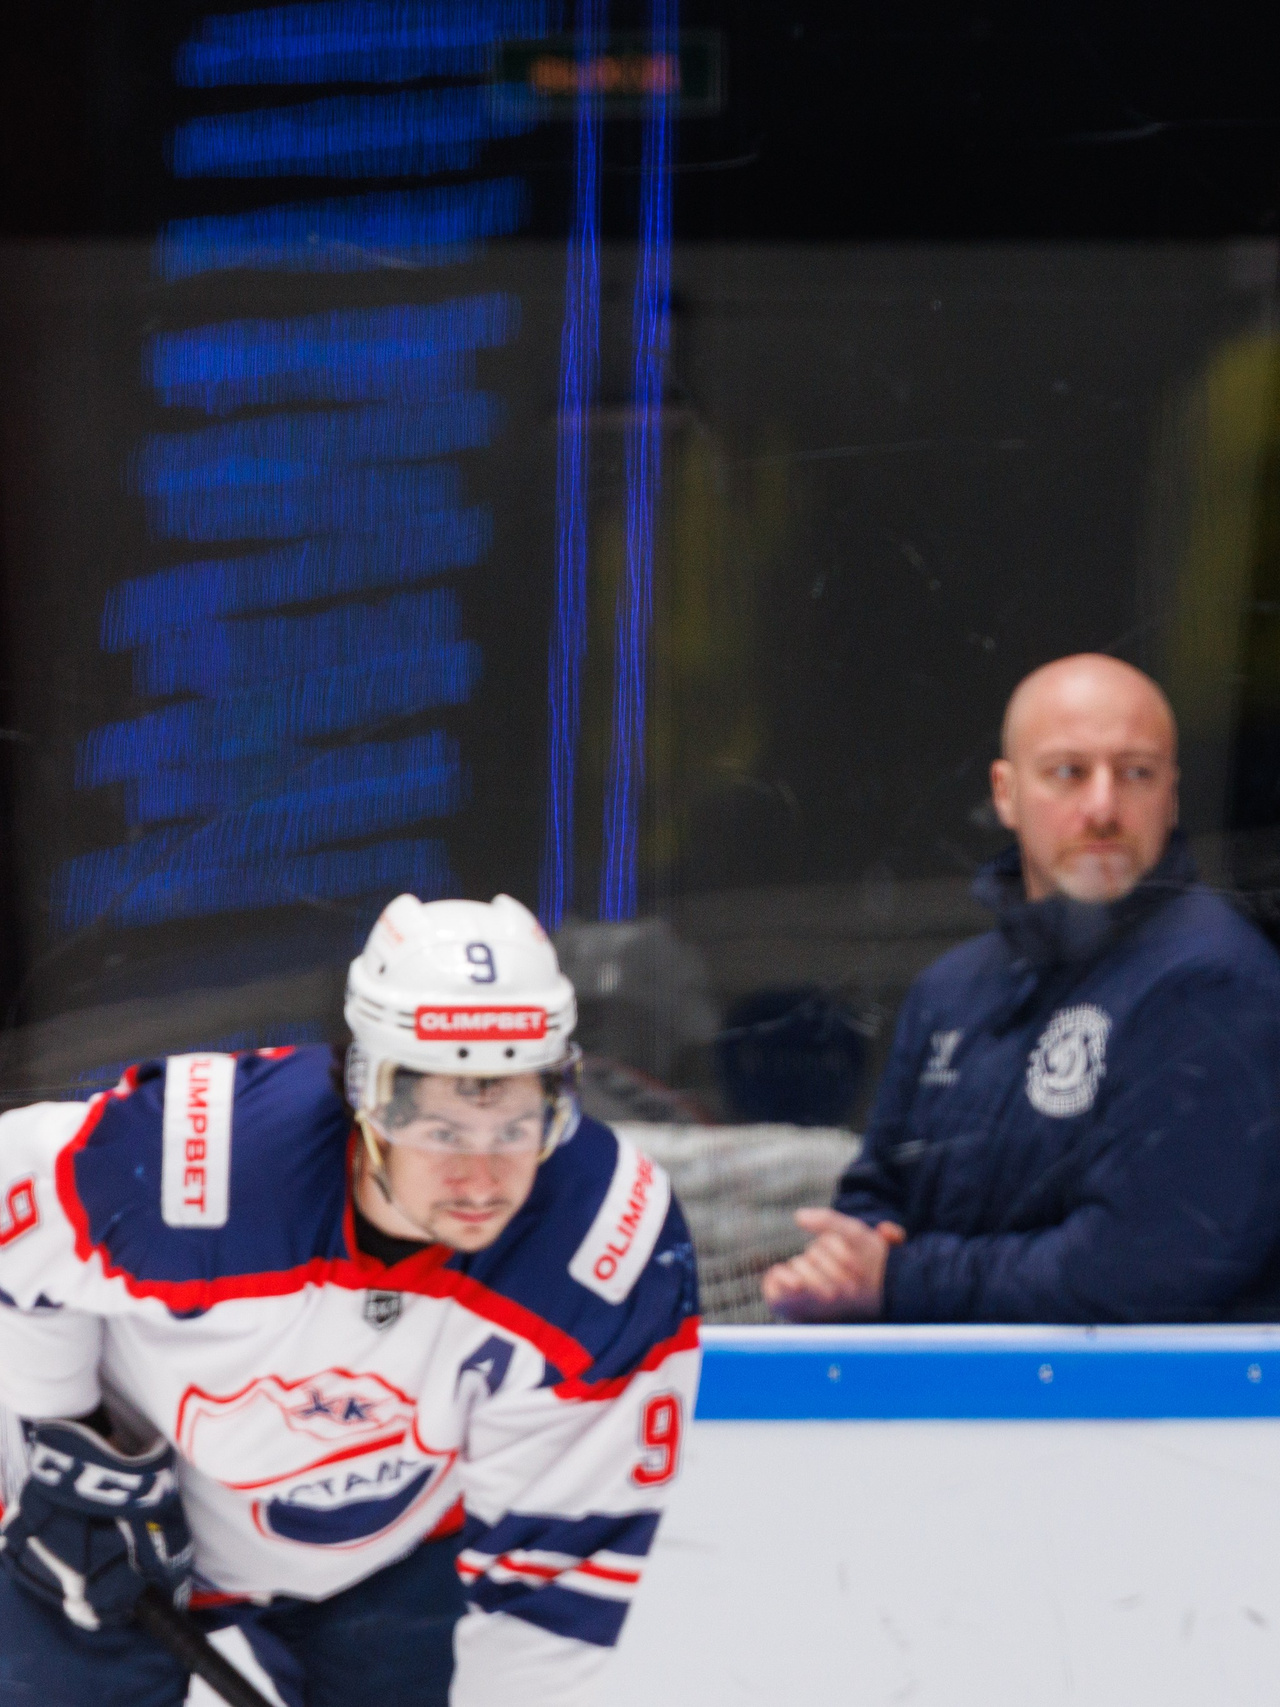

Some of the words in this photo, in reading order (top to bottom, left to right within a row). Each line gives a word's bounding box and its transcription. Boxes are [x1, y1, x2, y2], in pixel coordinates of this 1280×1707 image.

[465, 942, 498, 984] 9
[419, 1011, 543, 1032] OLIMPBET
[184, 1058, 211, 1213] LIMPBET
[630, 1389, 683, 1488] 9
